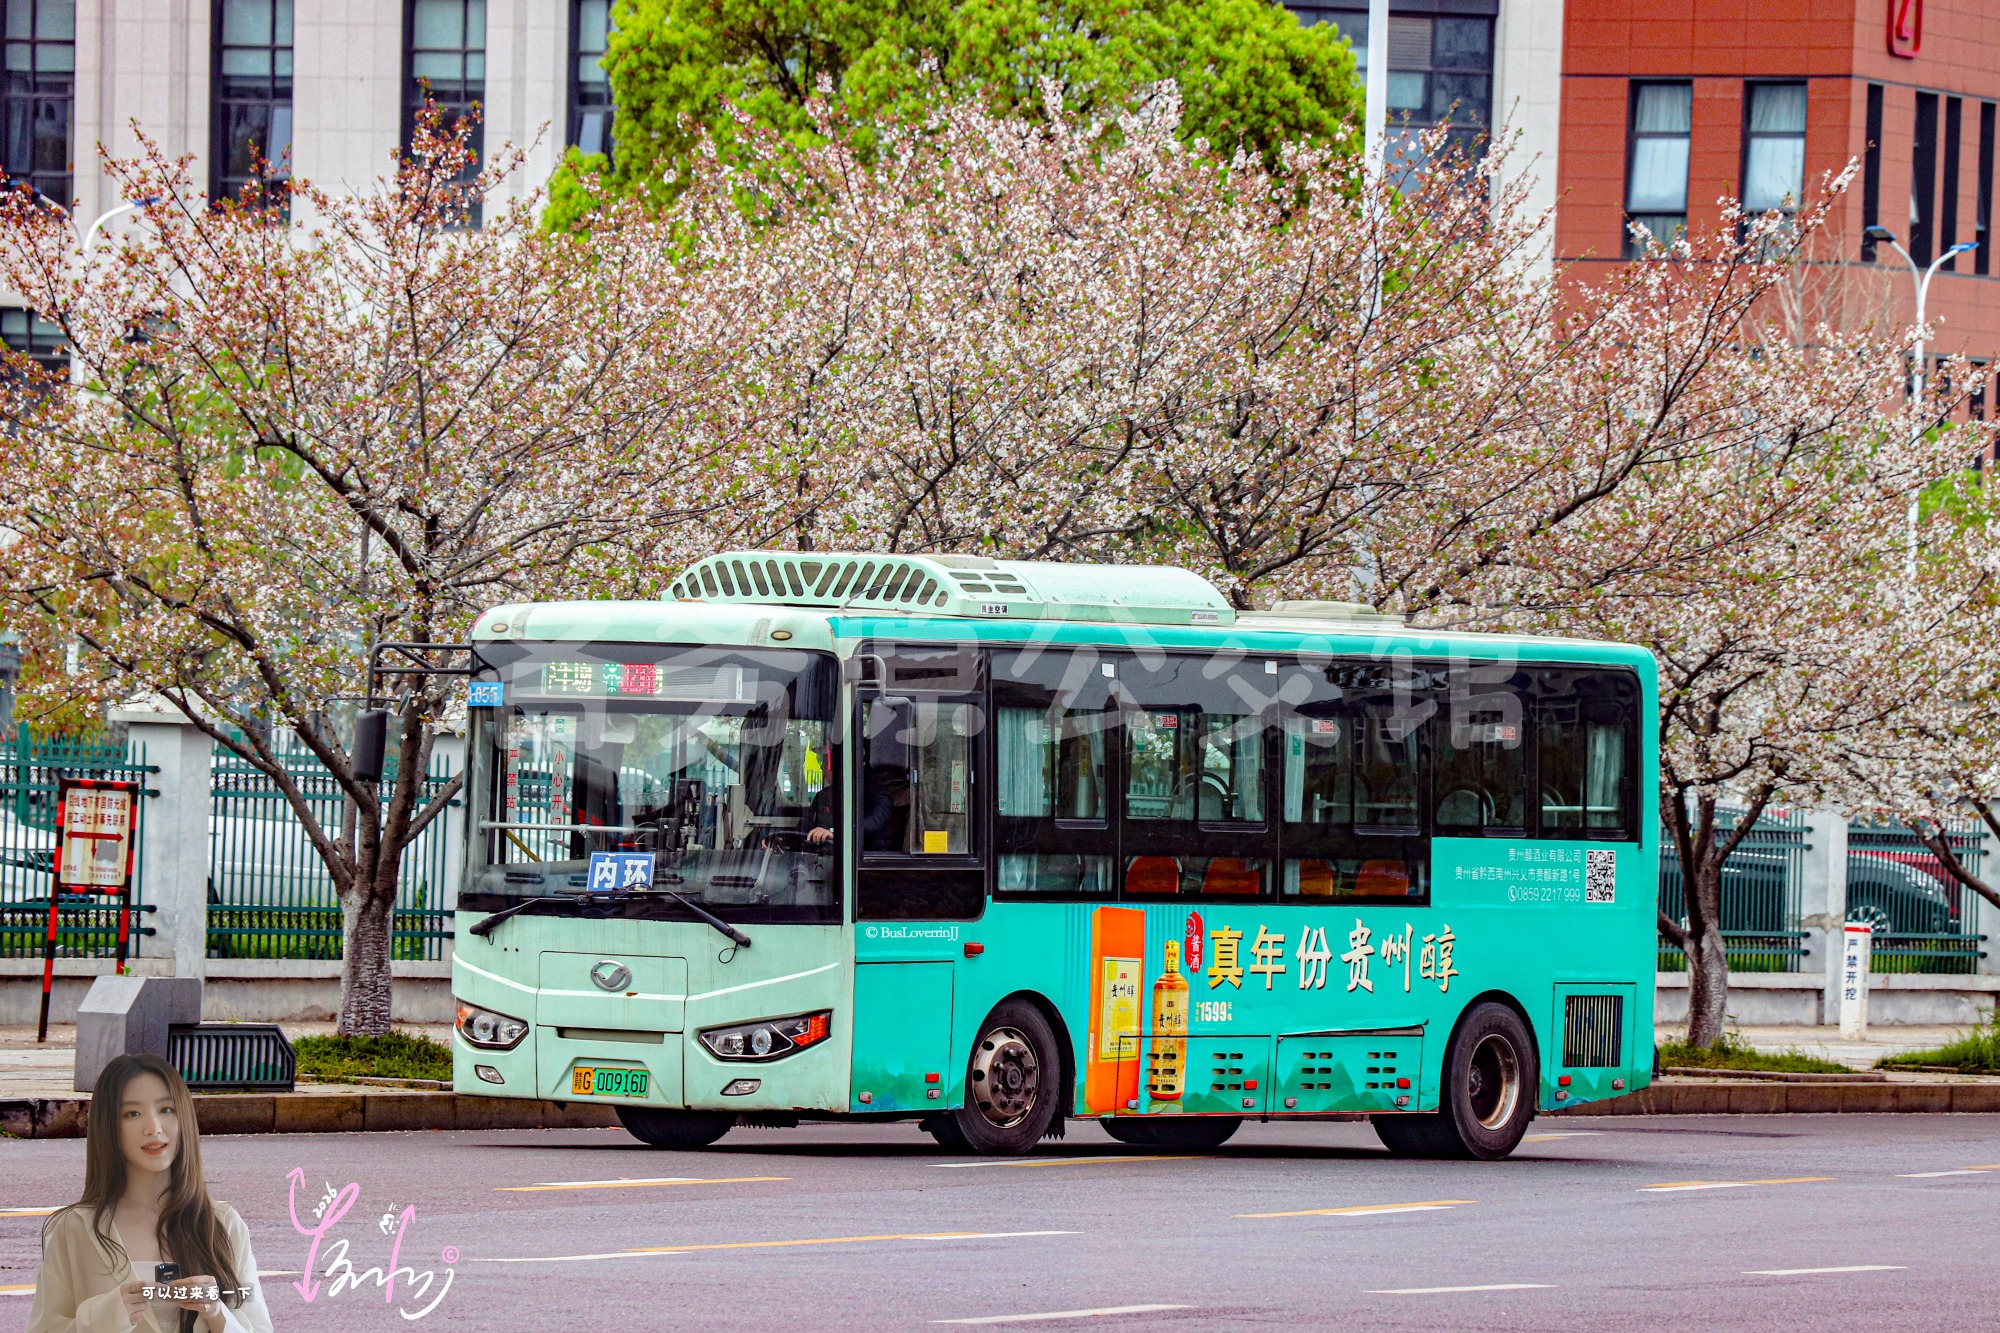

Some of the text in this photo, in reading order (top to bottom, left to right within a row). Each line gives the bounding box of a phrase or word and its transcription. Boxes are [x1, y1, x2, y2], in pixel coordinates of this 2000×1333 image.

[1508, 848, 1581, 863] 贵州醇酒业有限公司
[593, 857, 649, 889] 内环
[1517, 887, 1580, 902] 0859 2217 999
[1190, 934, 1201, 969] 酱酒
[1207, 918, 1459, 993] 真年份贵州醇
[1845, 938, 1858, 1000] 严禁开挖
[1200, 1001, 1227, 1022] 1599
